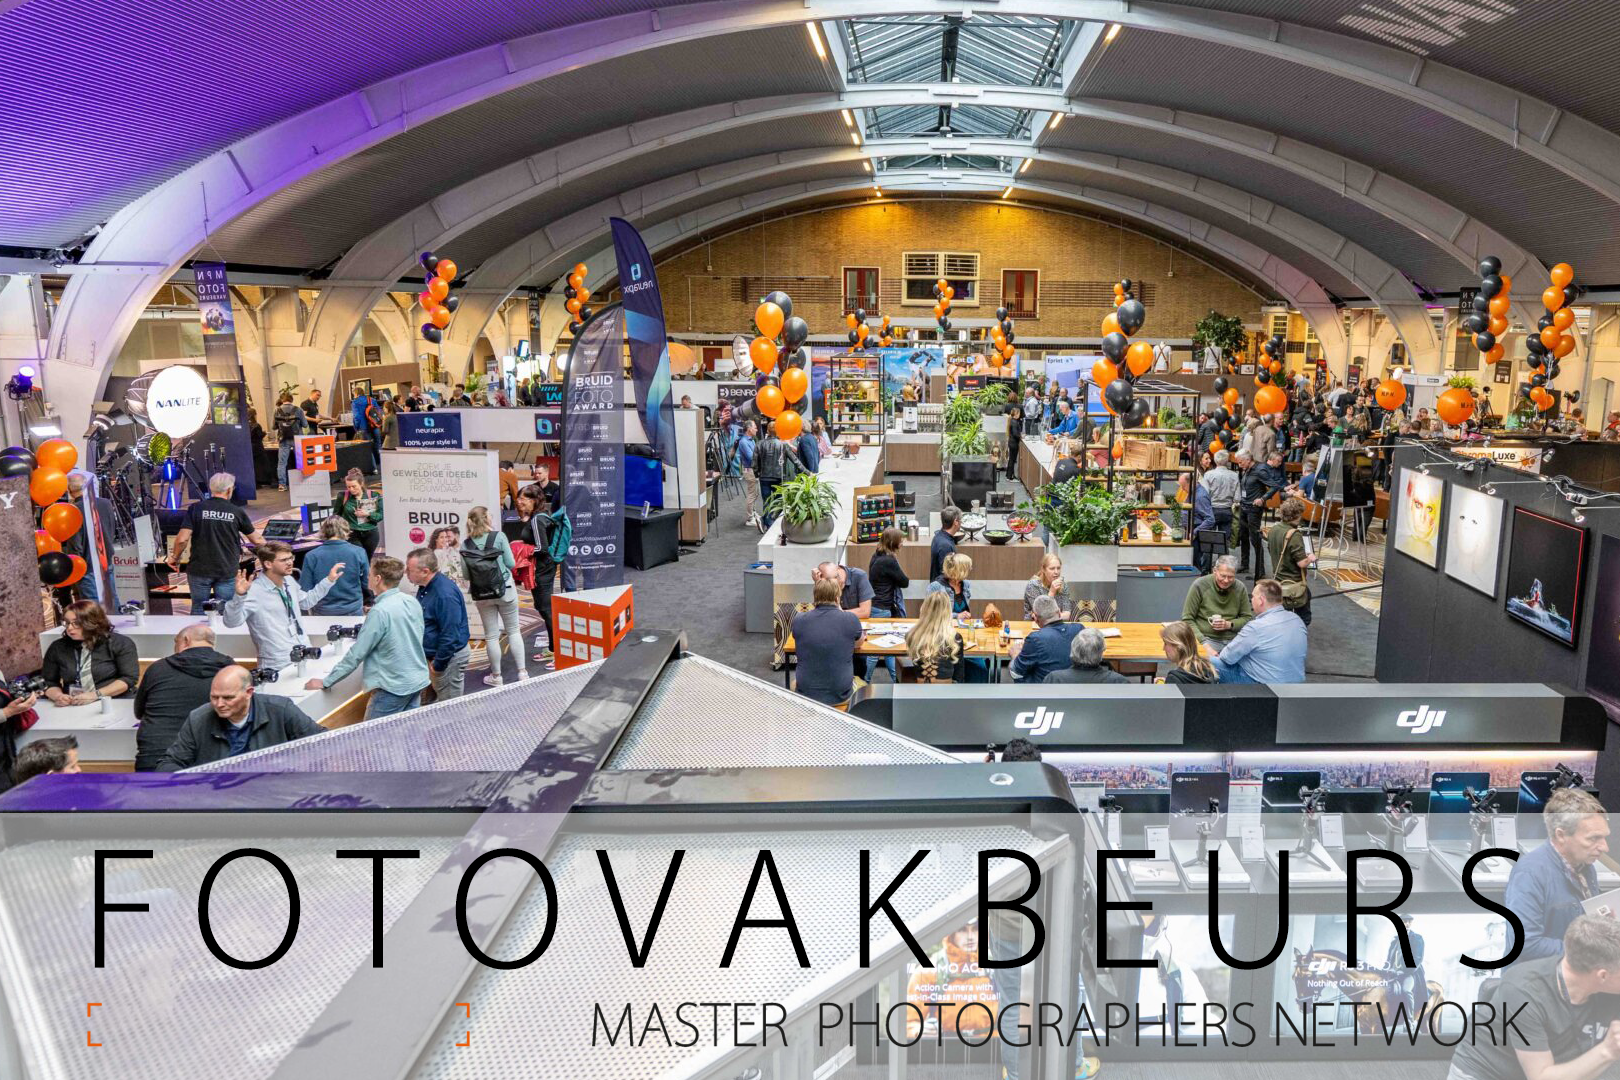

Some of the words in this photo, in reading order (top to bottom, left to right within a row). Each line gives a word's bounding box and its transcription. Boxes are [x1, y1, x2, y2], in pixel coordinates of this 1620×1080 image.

[575, 375, 613, 388] BRUID
[574, 389, 614, 404] FOTO
[730, 388, 757, 397] BENRO
[155, 397, 201, 409] NANLITE
[573, 402, 614, 411] AWARD
[415, 427, 445, 435] neurapix
[421, 439, 435, 447] your
[392, 469, 443, 478] GEWELDIGE
[202, 510, 235, 520] BRUID
[408, 511, 460, 525] BRUID
[113, 556, 139, 565] Bruid
[914, 983, 940, 991] Action
[942, 983, 974, 991] Camera
[975, 983, 994, 991] with
[1307, 979, 1338, 989] Nothing
[1339, 980, 1354, 988] Out
[1355, 979, 1364, 988] of
[1365, 979, 1389, 988] Reach
[952, 993, 978, 1002] Image
